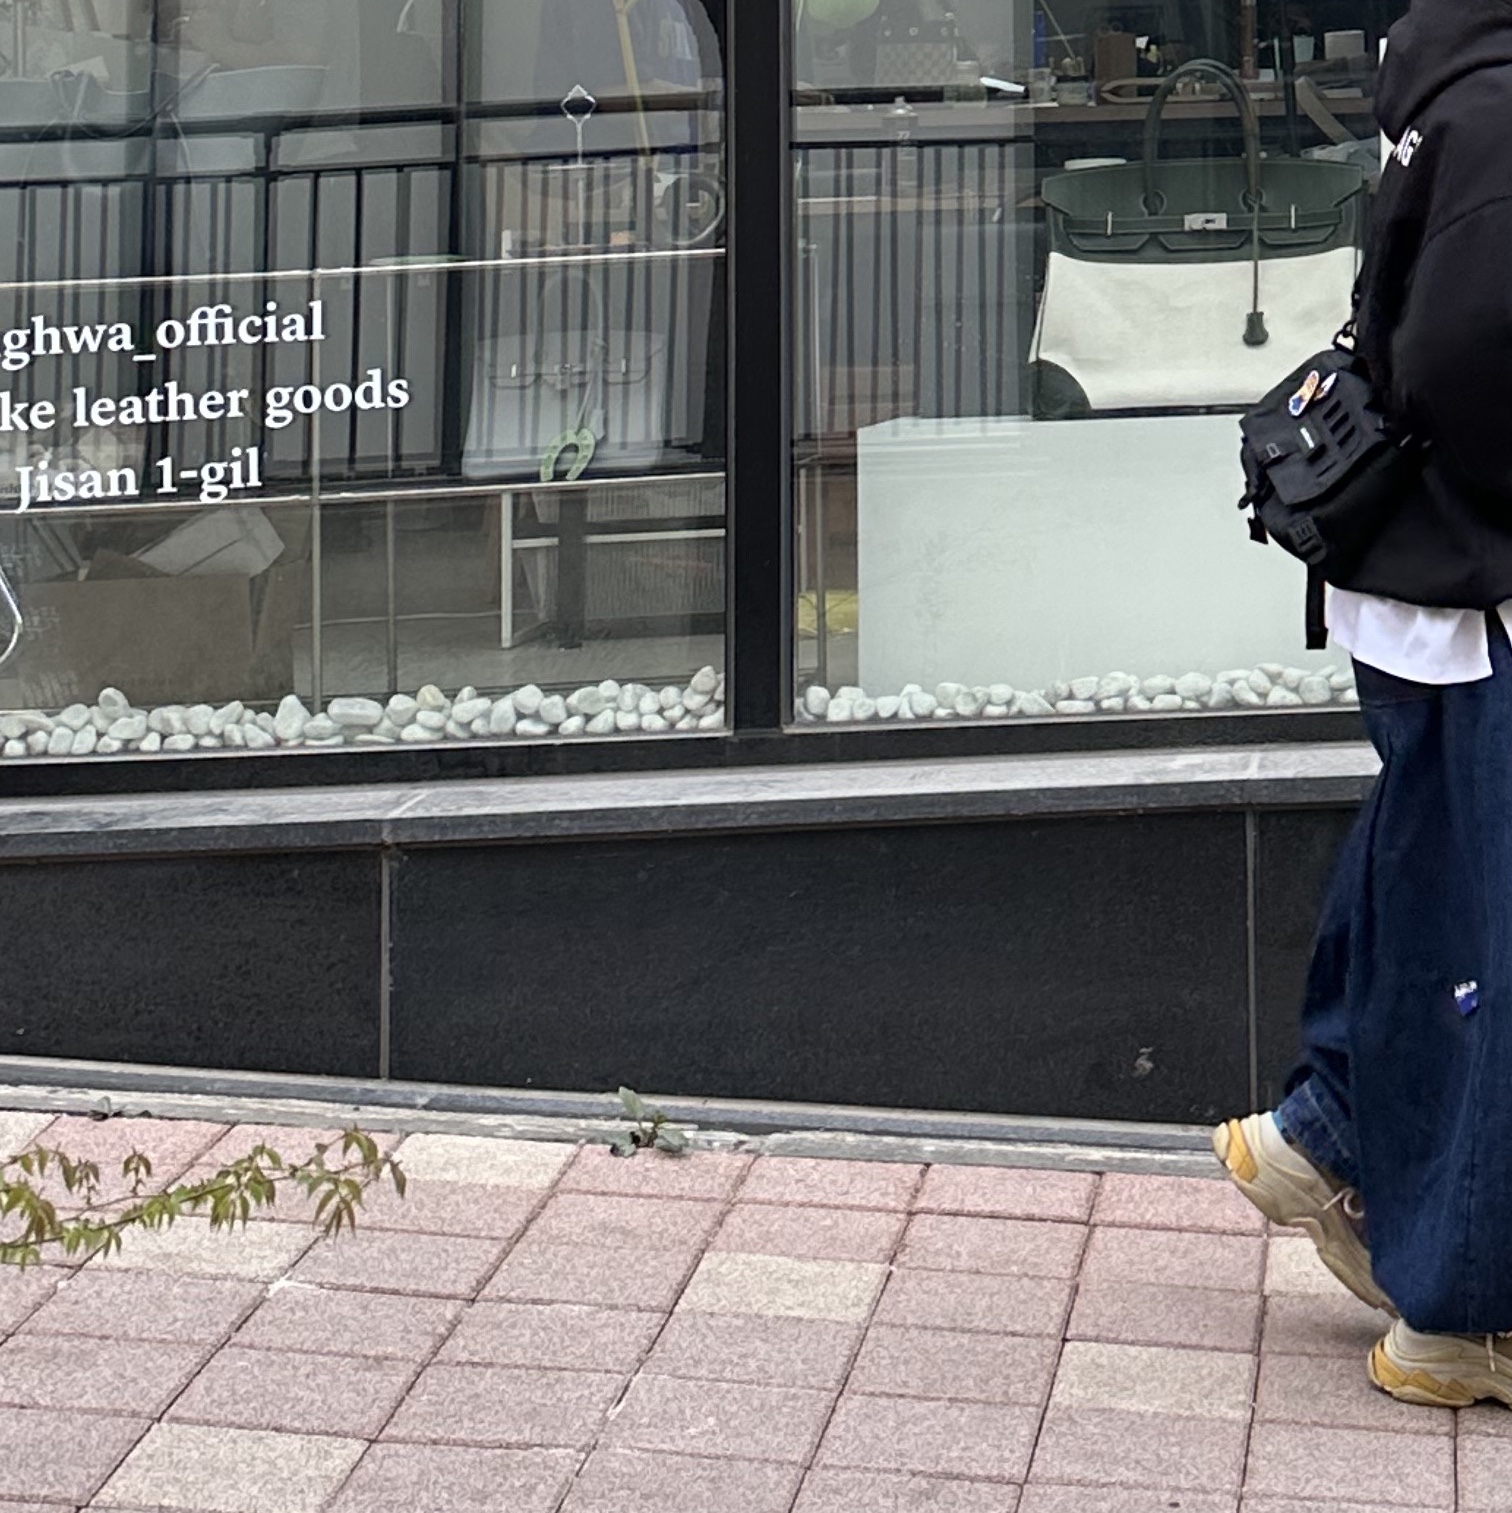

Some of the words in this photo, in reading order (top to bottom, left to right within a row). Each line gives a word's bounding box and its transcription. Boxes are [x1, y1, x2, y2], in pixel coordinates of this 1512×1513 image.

[0, 301, 325, 371] ghwa_official
[73, 382, 249, 427] leather
[264, 369, 411, 428] goods
[15, 461, 139, 513] Jisan
[155, 447, 262, 503] 1-gil
